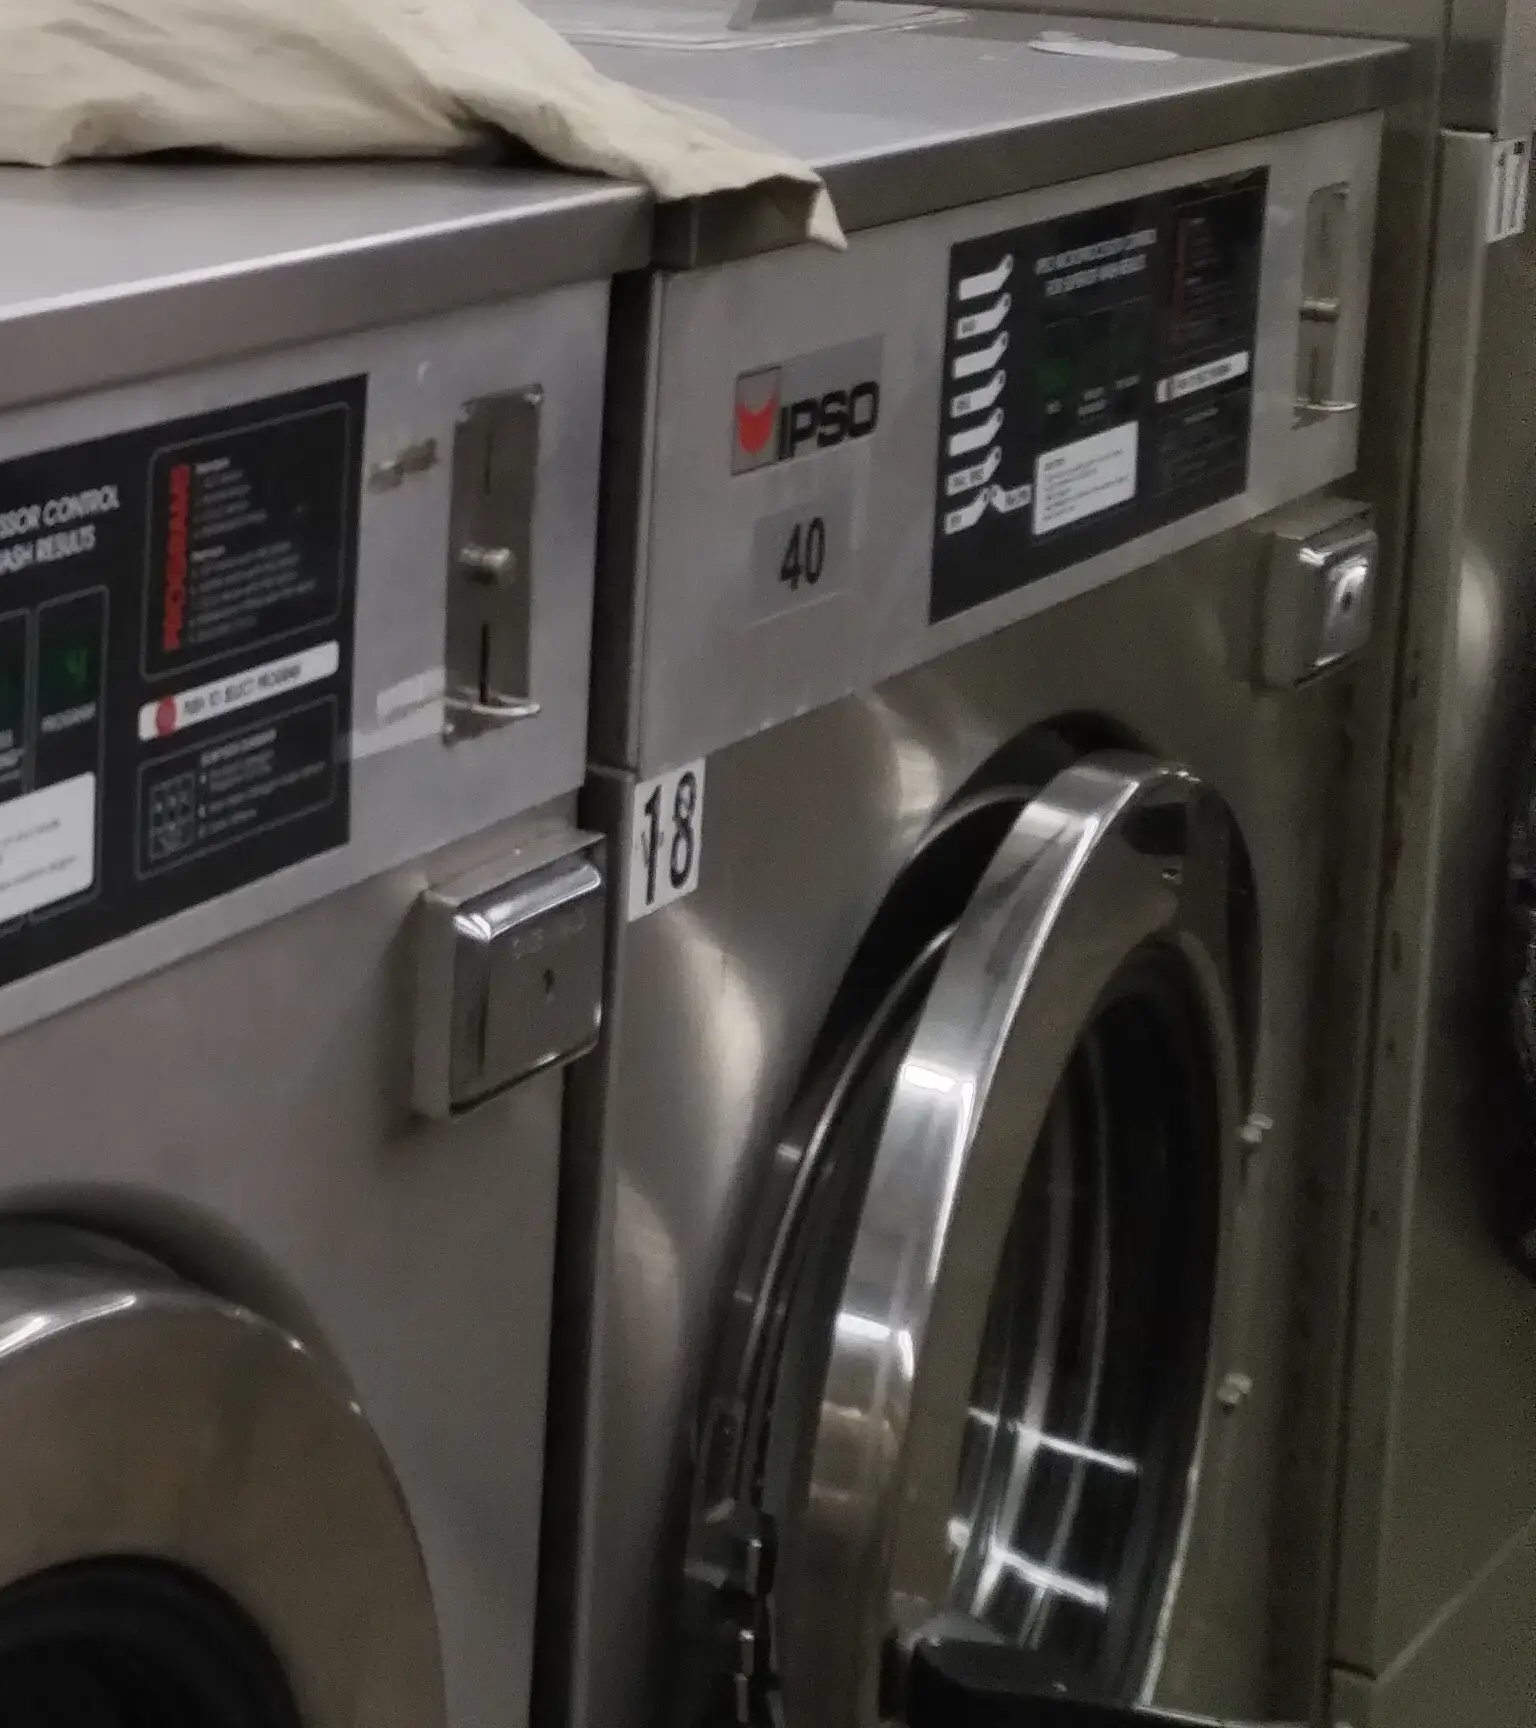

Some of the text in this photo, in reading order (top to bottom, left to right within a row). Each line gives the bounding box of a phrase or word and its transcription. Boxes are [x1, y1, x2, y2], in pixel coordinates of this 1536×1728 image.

[778, 380, 880, 461] IPSO
[43, 482, 122, 528] CONTROL
[780, 516, 827, 591] 40
[644, 771, 697, 906] 18
